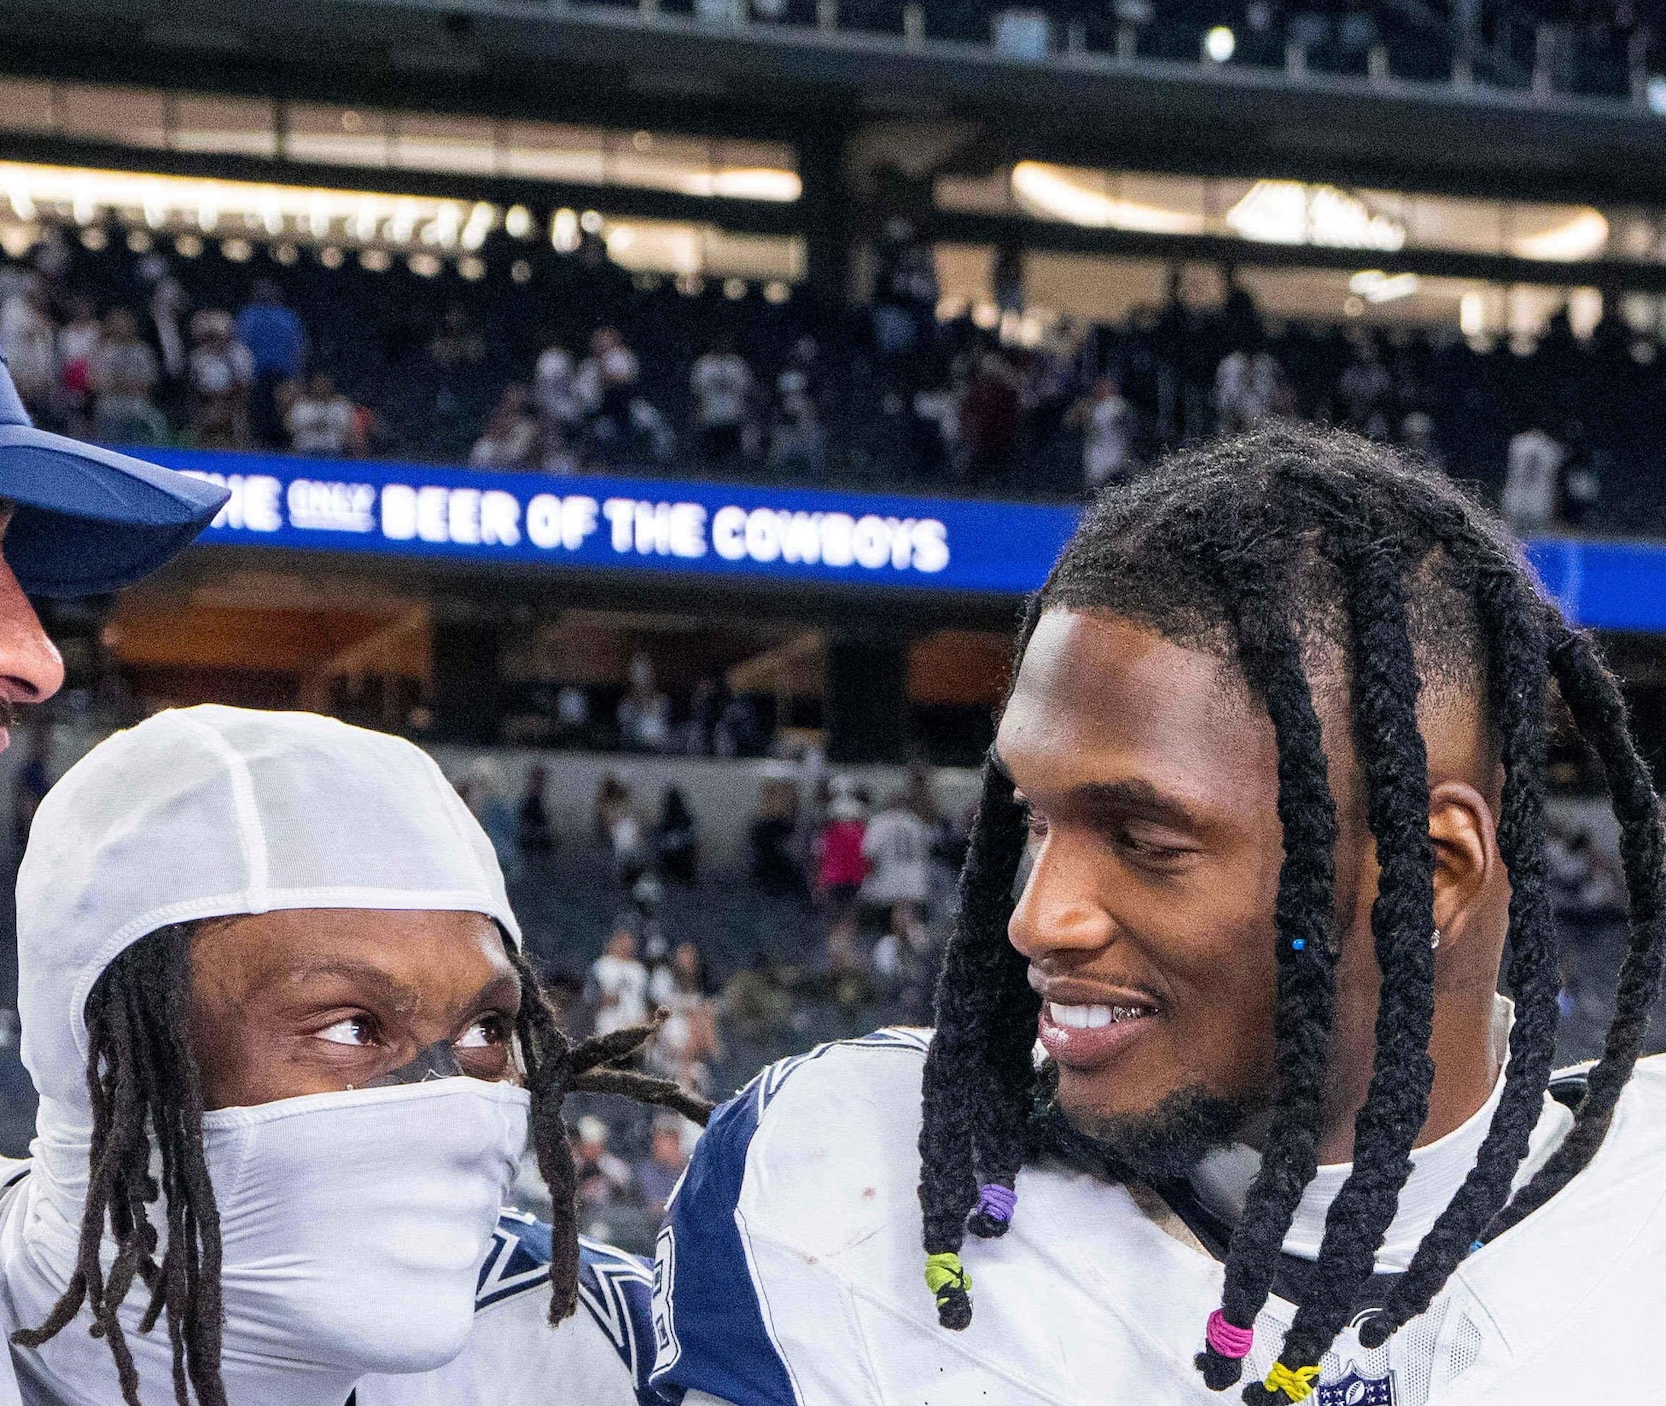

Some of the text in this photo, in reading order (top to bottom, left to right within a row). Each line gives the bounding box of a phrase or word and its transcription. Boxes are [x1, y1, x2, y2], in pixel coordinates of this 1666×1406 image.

[175, 470, 282, 532] HE
[381, 484, 521, 547] BEER
[526, 494, 598, 550] OF
[603, 497, 708, 558] THE
[712, 505, 951, 573] COWBOYS
